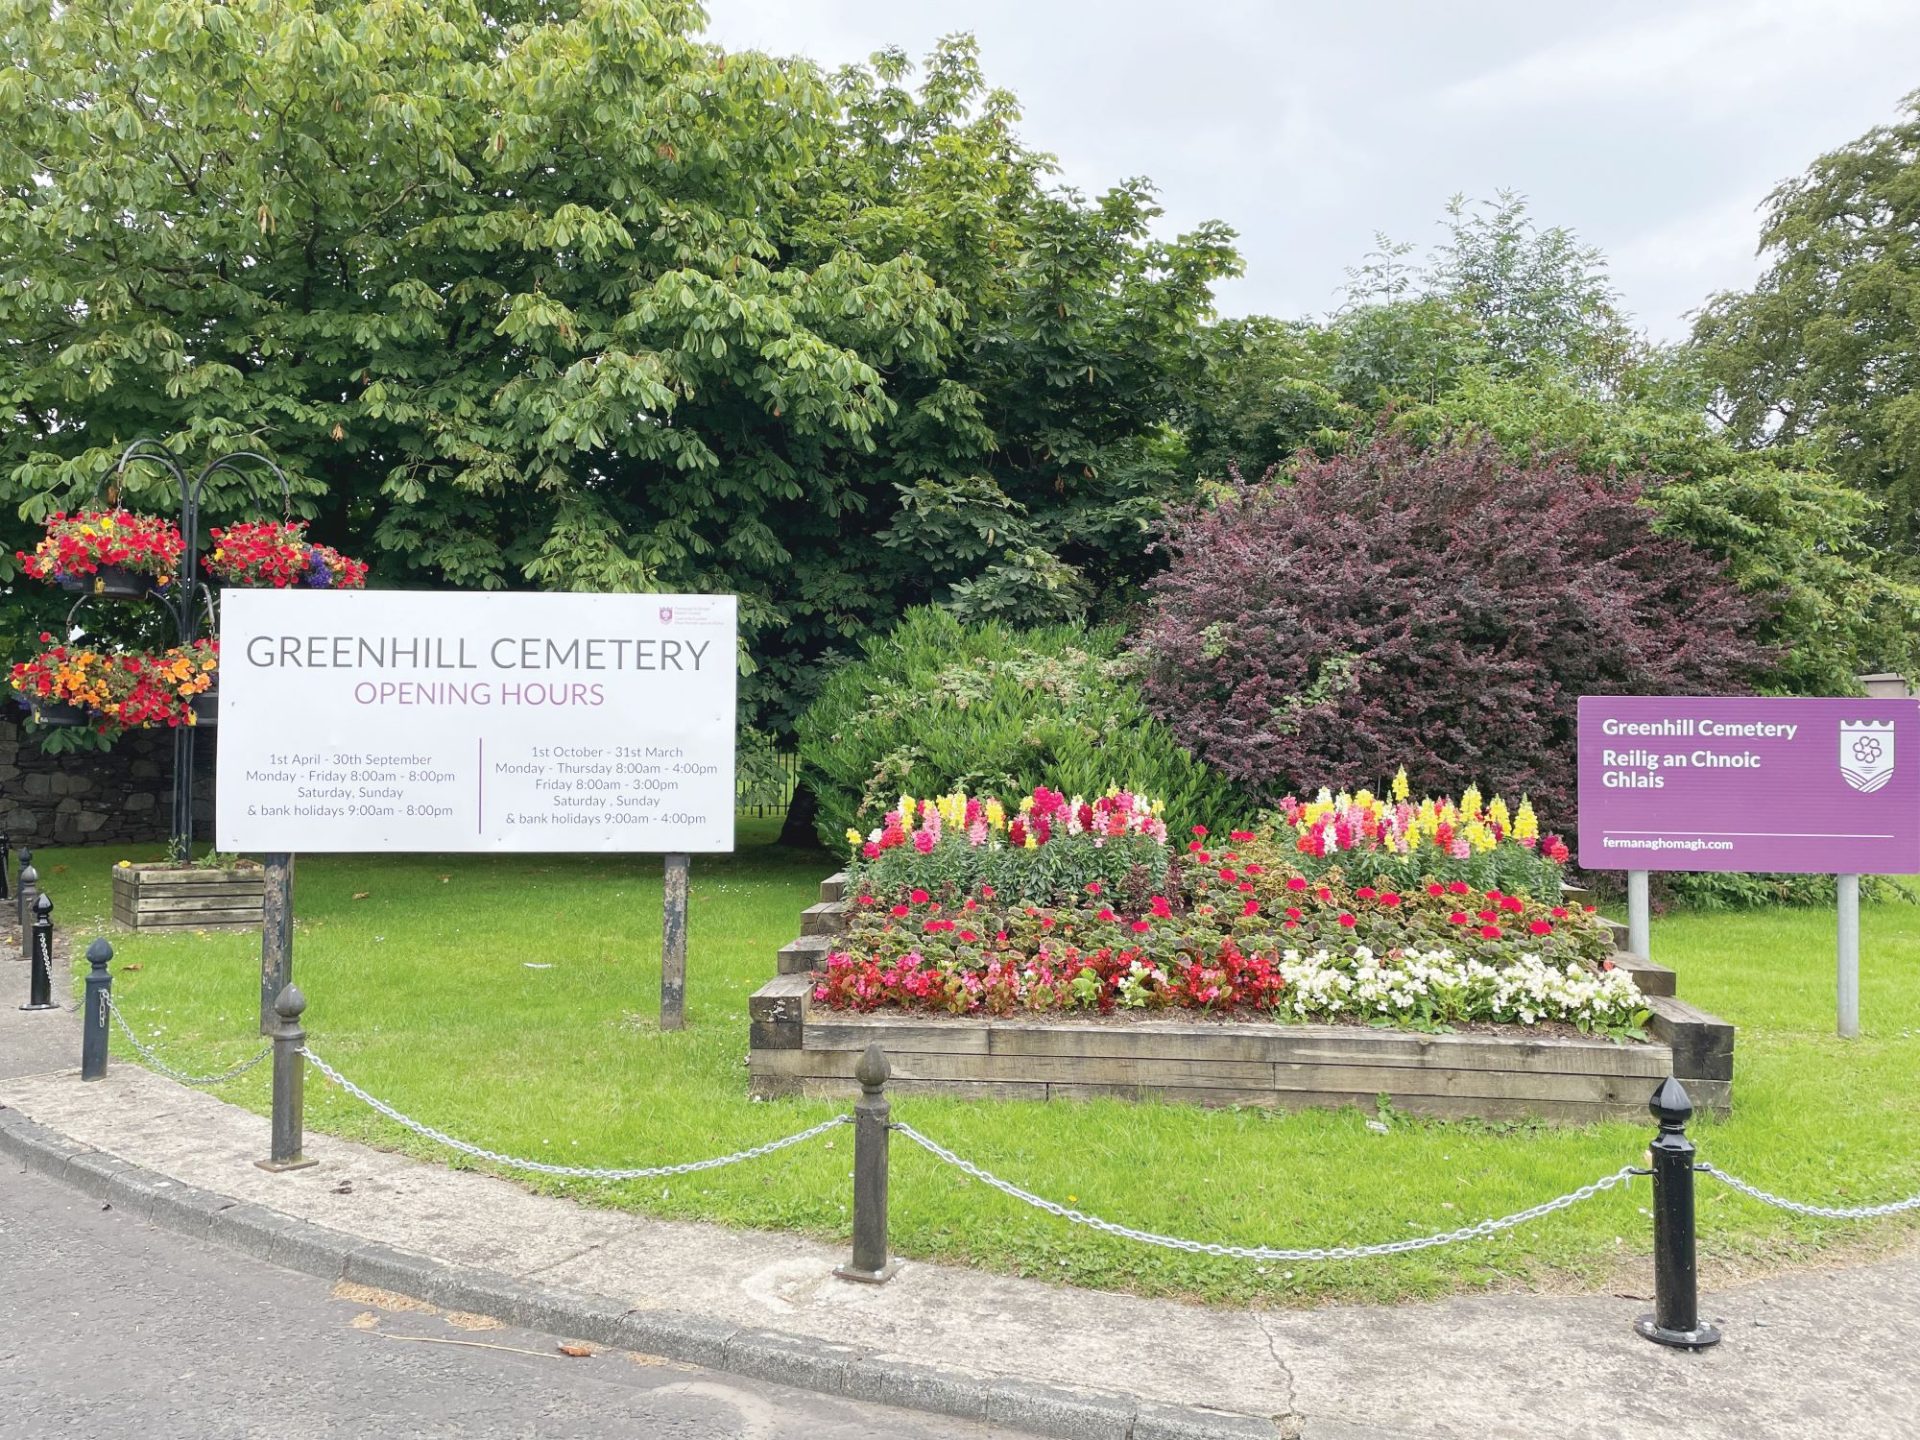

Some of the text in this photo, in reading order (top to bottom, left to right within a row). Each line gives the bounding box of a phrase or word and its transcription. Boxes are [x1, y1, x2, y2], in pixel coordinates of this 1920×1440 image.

[246, 635, 711, 671] GREENHILL CEMETERY
[354, 681, 605, 707] OPENING HOURS
[1602, 718, 1798, 741] Greenhill Cemetery
[532, 746, 550, 758] 1st
[553, 746, 604, 759] October
[615, 746, 641, 758] 31st
[645, 746, 684, 758] March
[1602, 749, 1761, 769] Reilig an Chnoic
[269, 753, 288, 766] 1st
[292, 753, 321, 767] April
[333, 753, 362, 766] 30th
[365, 753, 433, 768] September
[246, 770, 297, 784] Monday
[309, 770, 347, 784] Friday
[350, 770, 397, 783] 8:00am
[408, 770, 456, 784] 8:00pm
[495, 762, 545, 776] Monday
[556, 762, 612, 776] Thursday
[615, 763, 661, 775] 8:00am
[672, 763, 718, 777] 4:00pm
[535, 778, 573, 792] Friday
[575, 778, 621, 791] 8:00am
[632, 778, 679, 792] 3:00pm
[1602, 770, 1665, 789] Ghlais
[297, 786, 404, 800] Saturday, Sunday
[553, 795, 606, 809] Saturday
[616, 795, 660, 809] Sunday
[247, 805, 257, 817] &
[261, 804, 290, 817] bank
[294, 804, 345, 818] holidays
[348, 804, 394, 817] 9:00am
[406, 804, 454, 819] 8:00pm
[505, 813, 516, 825] &
[519, 812, 548, 825] bank
[551, 812, 601, 827] holidays
[604, 812, 649, 826] 9:00am
[660, 812, 707, 827] 4:00pm
[1602, 837, 1734, 852] fermanaghomagh.com
